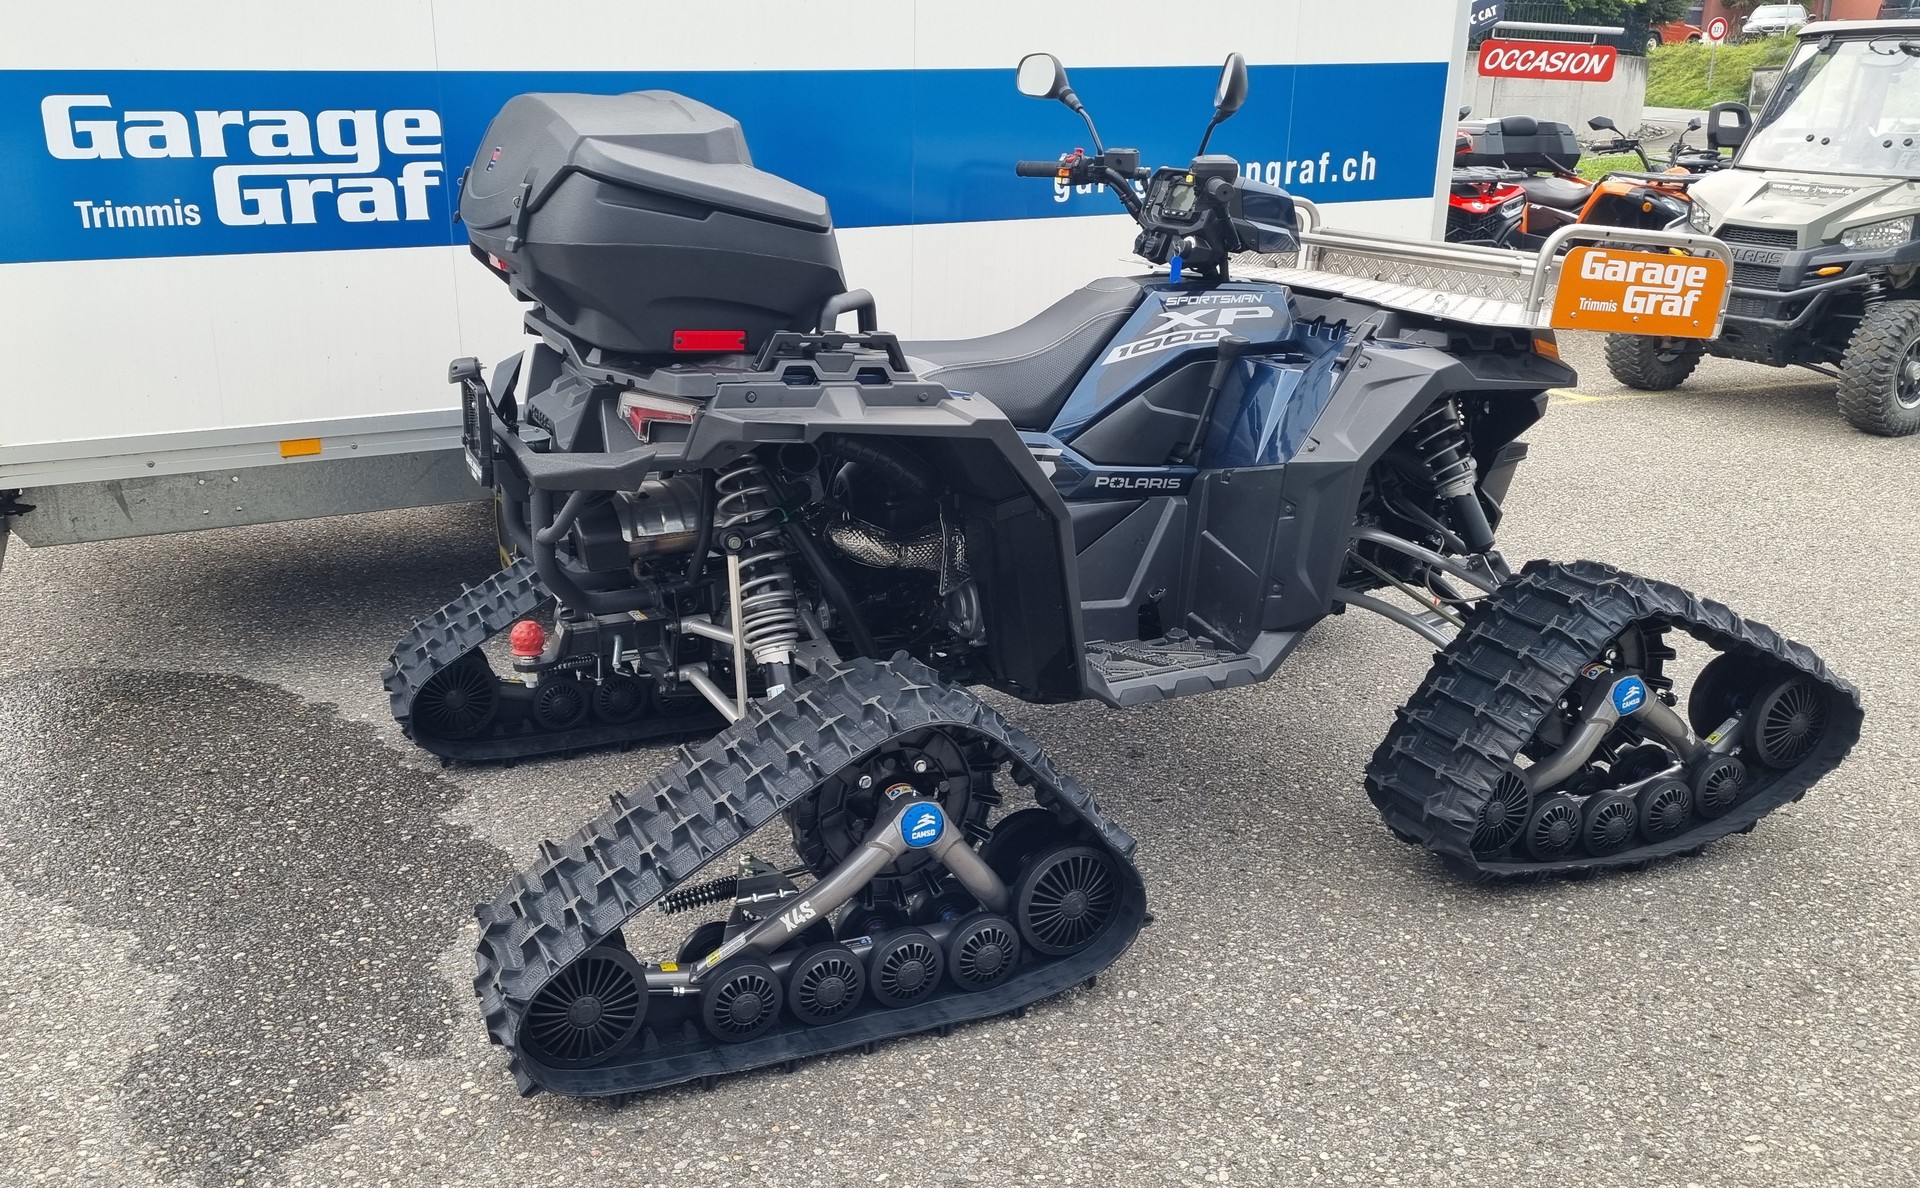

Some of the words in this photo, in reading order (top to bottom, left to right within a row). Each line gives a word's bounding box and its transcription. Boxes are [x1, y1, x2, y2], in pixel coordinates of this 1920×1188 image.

[1478, 4, 1497, 21] CAT
[1484, 48, 1610, 75] OCCASION
[41, 94, 442, 173] Garage
[74, 198, 201, 229] Trimmis
[213, 161, 443, 226] Graf
[1580, 250, 1707, 294] Garage
[1165, 294, 1263, 306] SPORTSMAN
[1579, 297, 1618, 312] Trimmis
[1622, 286, 1702, 317] Graf
[1145, 306, 1274, 335] XP
[1118, 330, 1220, 358] 1000
[1094, 476, 1181, 489] POLARIS
[911, 828, 936, 840] CAMSO
[779, 900, 817, 932] X4S
